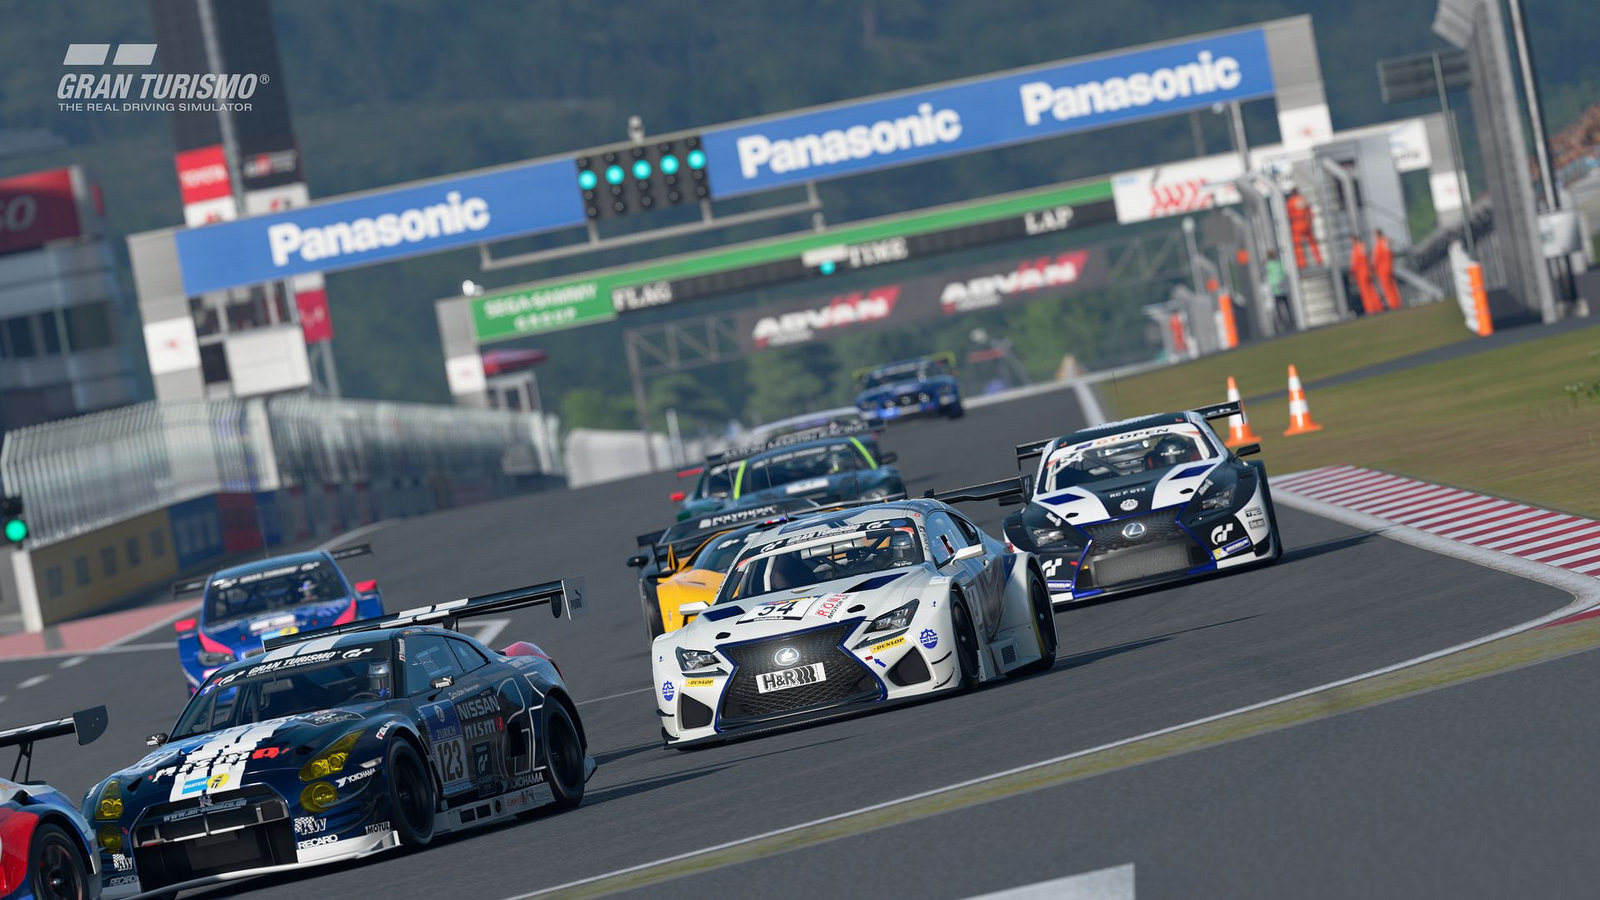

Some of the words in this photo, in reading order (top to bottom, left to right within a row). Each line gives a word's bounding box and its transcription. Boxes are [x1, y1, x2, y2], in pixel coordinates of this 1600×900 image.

[1020, 50, 1241, 126] Panasonic
[737, 103, 962, 179] Panasonic
[268, 191, 490, 267] Panasonic
[1024, 206, 1075, 236] LAP
[848, 236, 909, 269] TIME
[611, 281, 673, 311] FLAG
[787, 531, 814, 546] GRAN
[815, 524, 860, 539] TURISMO
[816, 592, 848, 617] ROWE
[876, 637, 905, 651] DUNLOP
[248, 660, 280, 675] GRAN
[457, 694, 501, 720] NISSAN
[436, 739, 465, 784] 123
[347, 768, 376, 784] YOKOHAMA
[366, 821, 390, 834] MOTUL
[297, 834, 339, 849] RECARO
